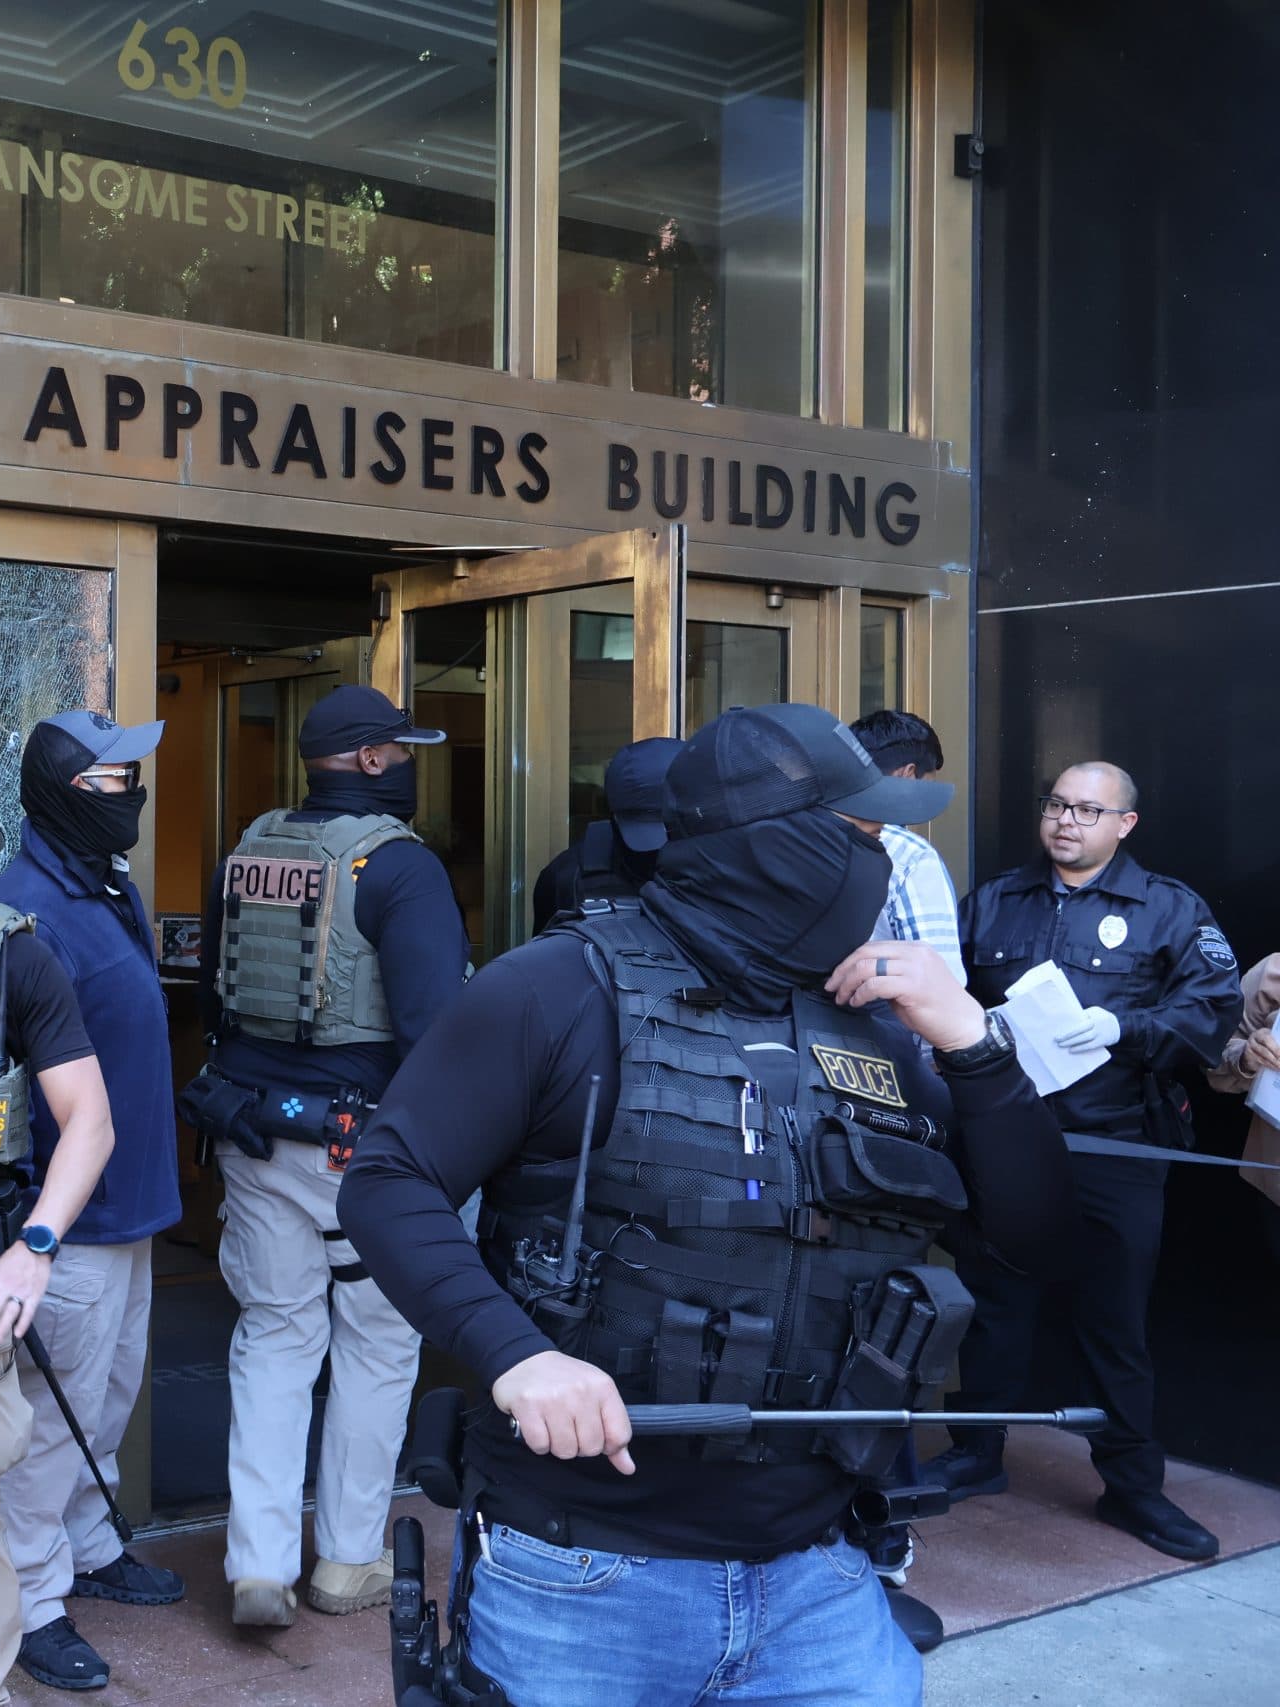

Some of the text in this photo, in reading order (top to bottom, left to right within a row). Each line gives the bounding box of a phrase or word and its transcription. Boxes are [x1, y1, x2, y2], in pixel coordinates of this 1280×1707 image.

[119, 18, 246, 109] 630
[225, 183, 368, 254] STREET
[23, 366, 550, 503] APPRAISERS
[607, 443, 920, 546] BUILDING
[228, 863, 322, 902] POLICE
[821, 1051, 897, 1100] POLICE
